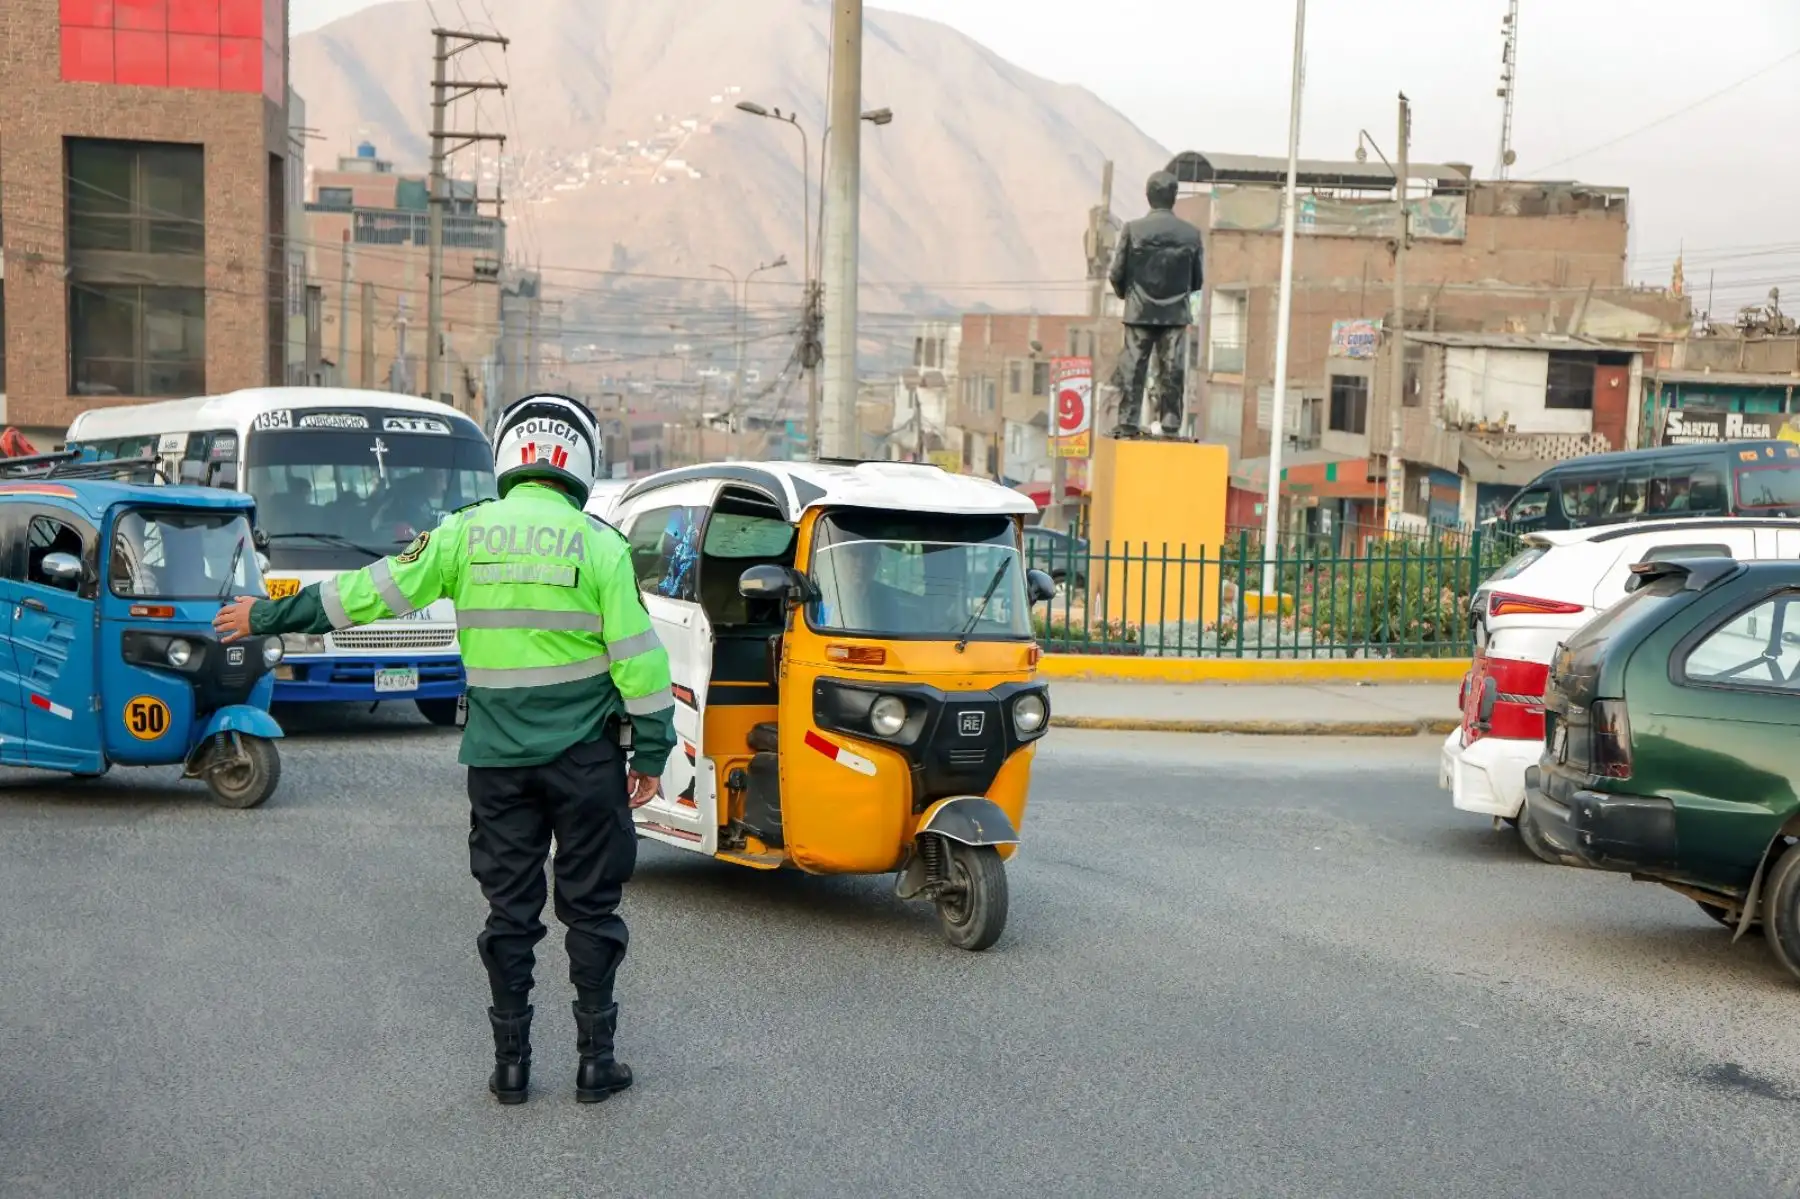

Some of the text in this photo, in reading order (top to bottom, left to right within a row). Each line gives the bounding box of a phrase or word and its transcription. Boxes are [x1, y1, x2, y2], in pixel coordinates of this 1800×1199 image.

[256, 410, 289, 428] 1354
[386, 419, 442, 431] ATE
[1667, 411, 1771, 438] SANTA ROSA
[515, 420, 579, 447] POLICIA
[467, 525, 585, 561] POLICIA
[132, 703, 164, 733] 50
[963, 719, 980, 731] RE
